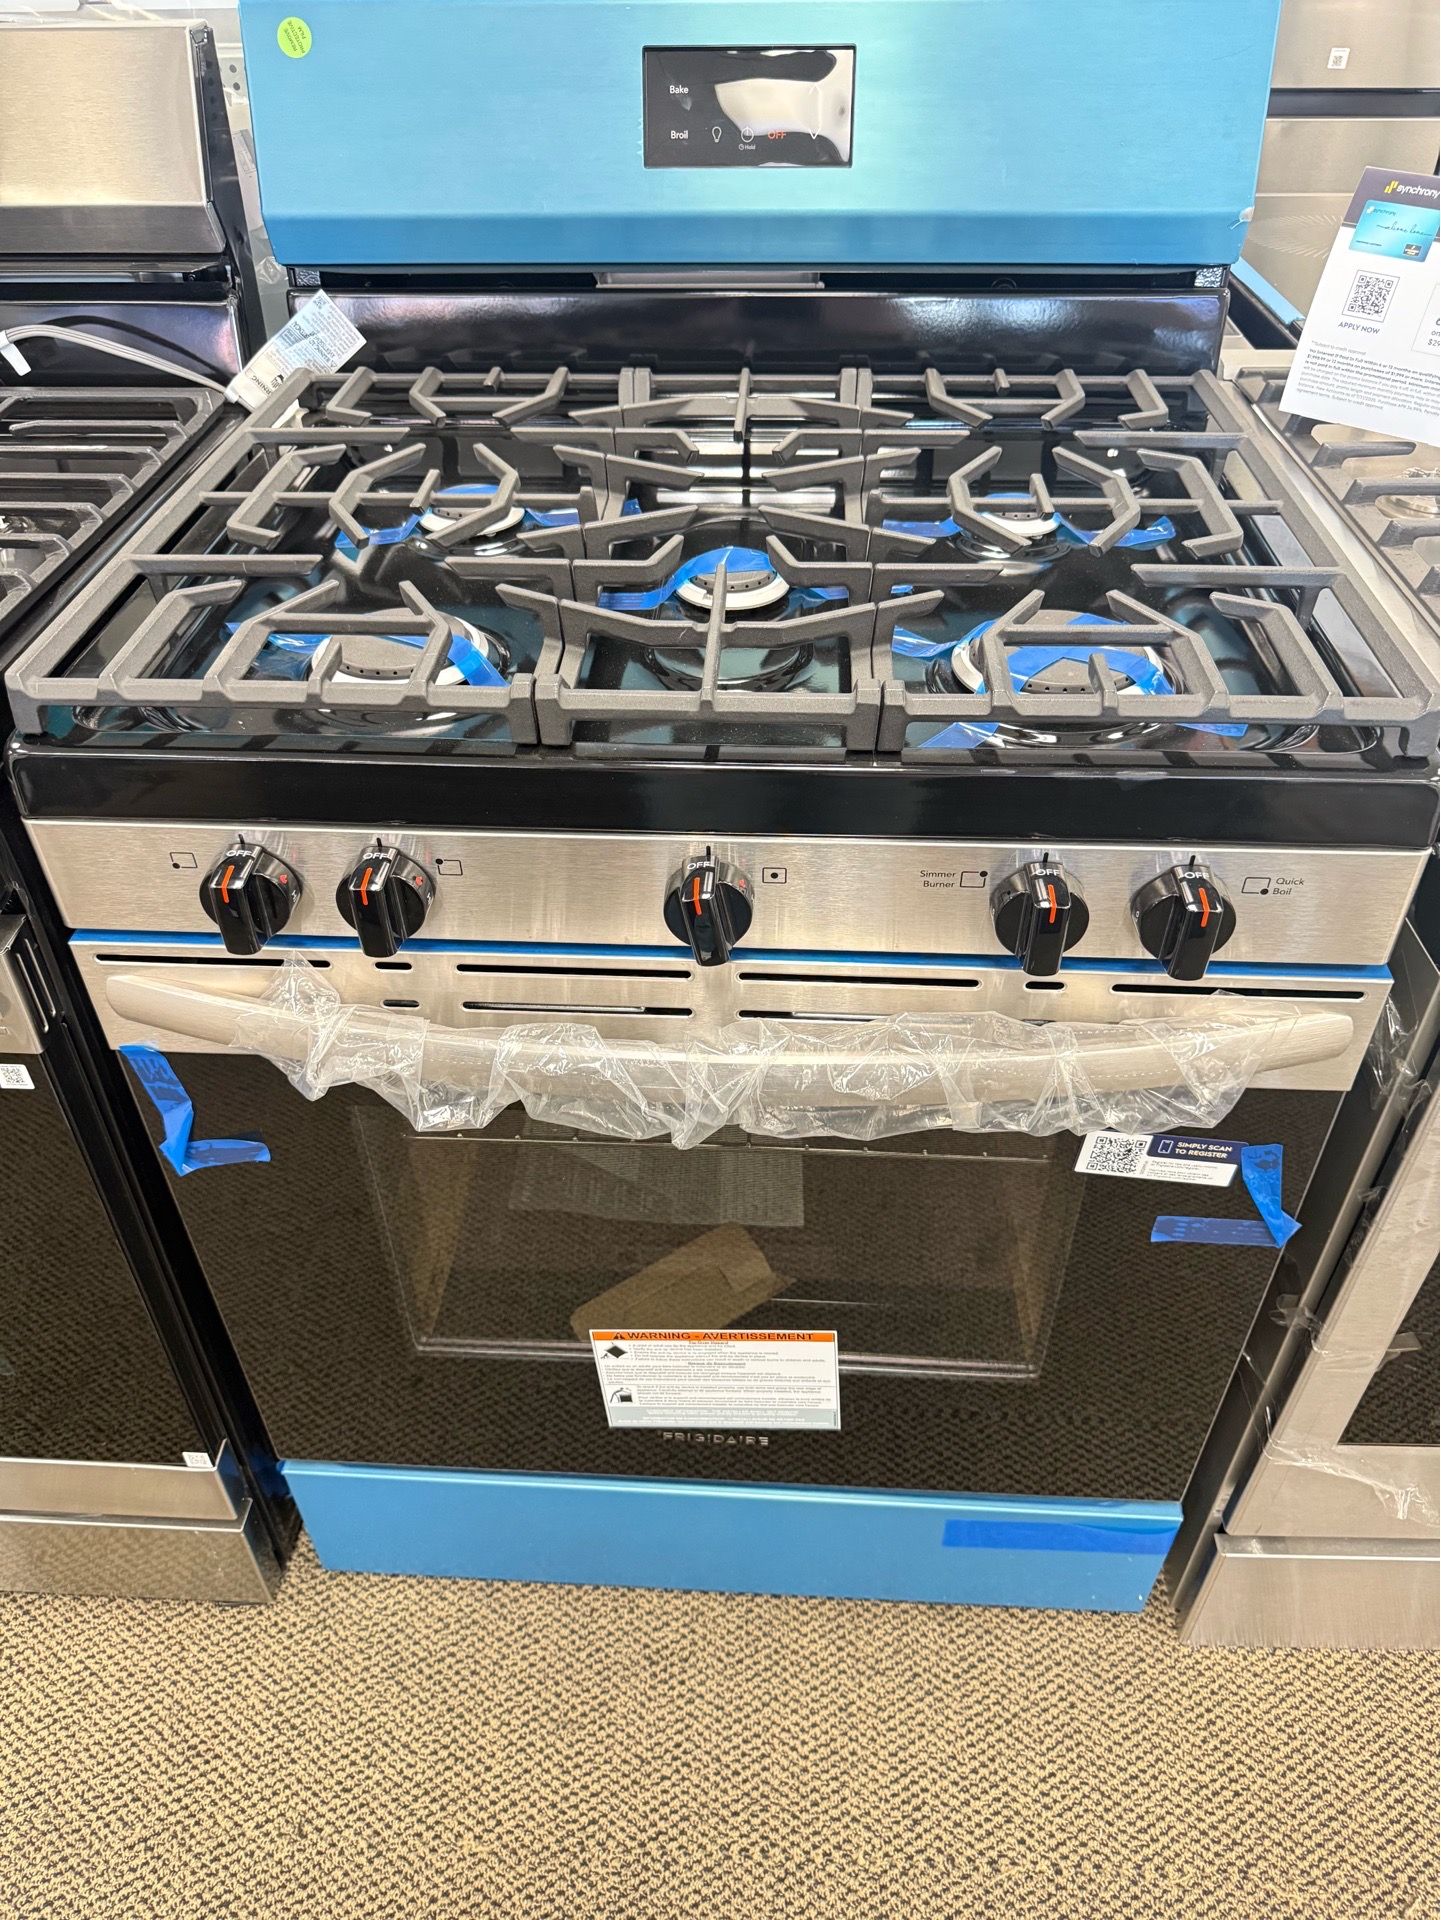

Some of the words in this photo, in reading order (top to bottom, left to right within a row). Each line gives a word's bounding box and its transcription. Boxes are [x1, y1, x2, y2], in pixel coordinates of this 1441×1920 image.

[288, 20, 305, 53] PROTECTIVE
[298, 26, 306, 39] FILM
[283, 28, 297, 51] REMOVE
[670, 85, 689, 94] Bake
[671, 130, 689, 139] Broil
[768, 131, 786, 139] OFF
[1396, 184, 1440, 199] synchrony
[1338, 321, 1360, 331] APPLY
[1361, 325, 1380, 334] NOW
[226, 849, 251, 857] OFF
[363, 851, 389, 859] OFF
[687, 862, 711, 870] OFF
[920, 869, 956, 878] Simmer
[1036, 868, 1060, 876] OFF
[1184, 871, 1210, 879] OFF
[923, 880, 955, 888] Burner
[1276, 877, 1305, 886] Quick
[1272, 887, 1293, 896] Boil
[1177, 1141, 1207, 1150] SIMPLY
[1208, 1143, 1233, 1152] SCAN
[1188, 1149, 1228, 1159] REGISTER
[702, 1332, 814, 1340] AVERTISSEMENT
[662, 1431, 769, 1446] FRIGIDAIRE
